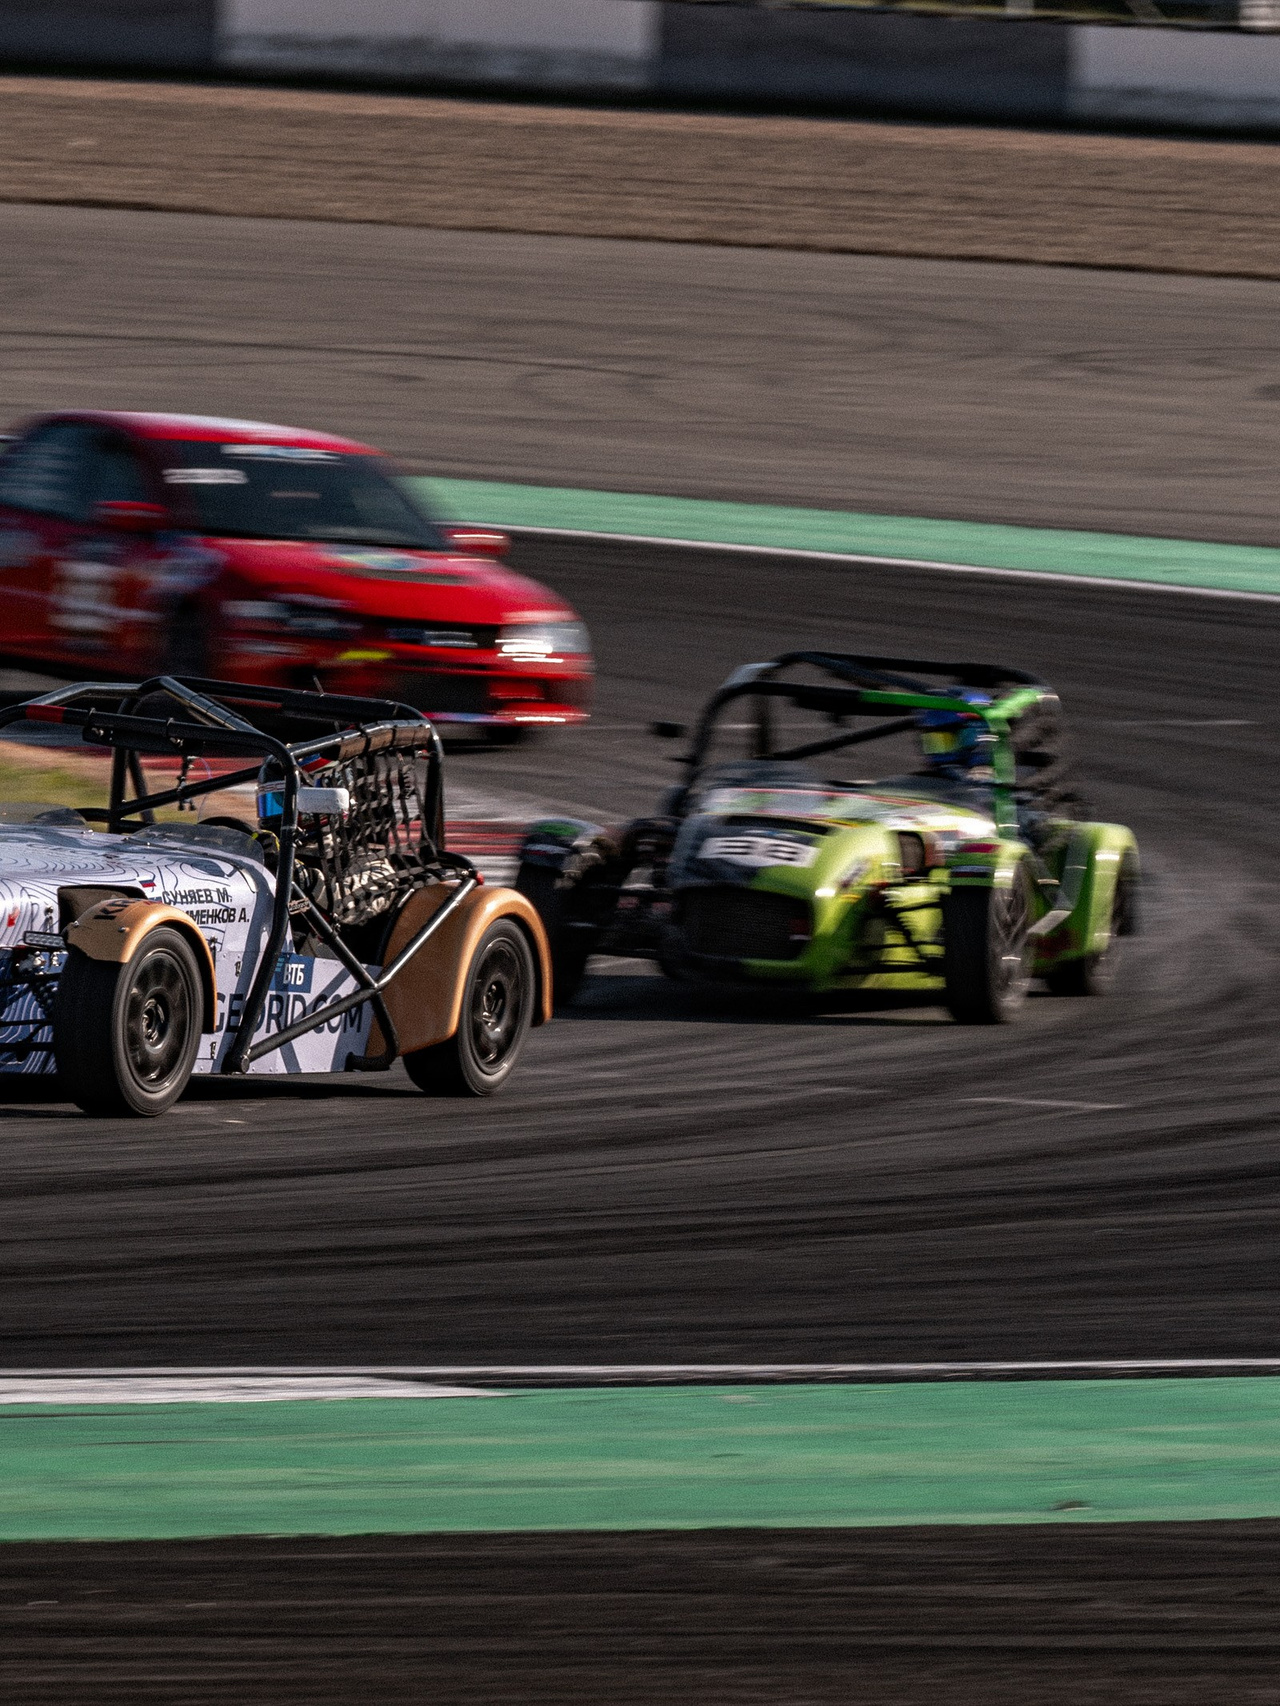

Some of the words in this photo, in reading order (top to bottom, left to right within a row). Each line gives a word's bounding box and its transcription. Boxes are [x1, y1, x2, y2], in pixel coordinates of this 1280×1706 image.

[216, 888, 233, 903] М.
[185, 908, 236, 925] МЕНКОВ
[238, 907, 250, 923] А.
[283, 963, 306, 985] ВТБ
